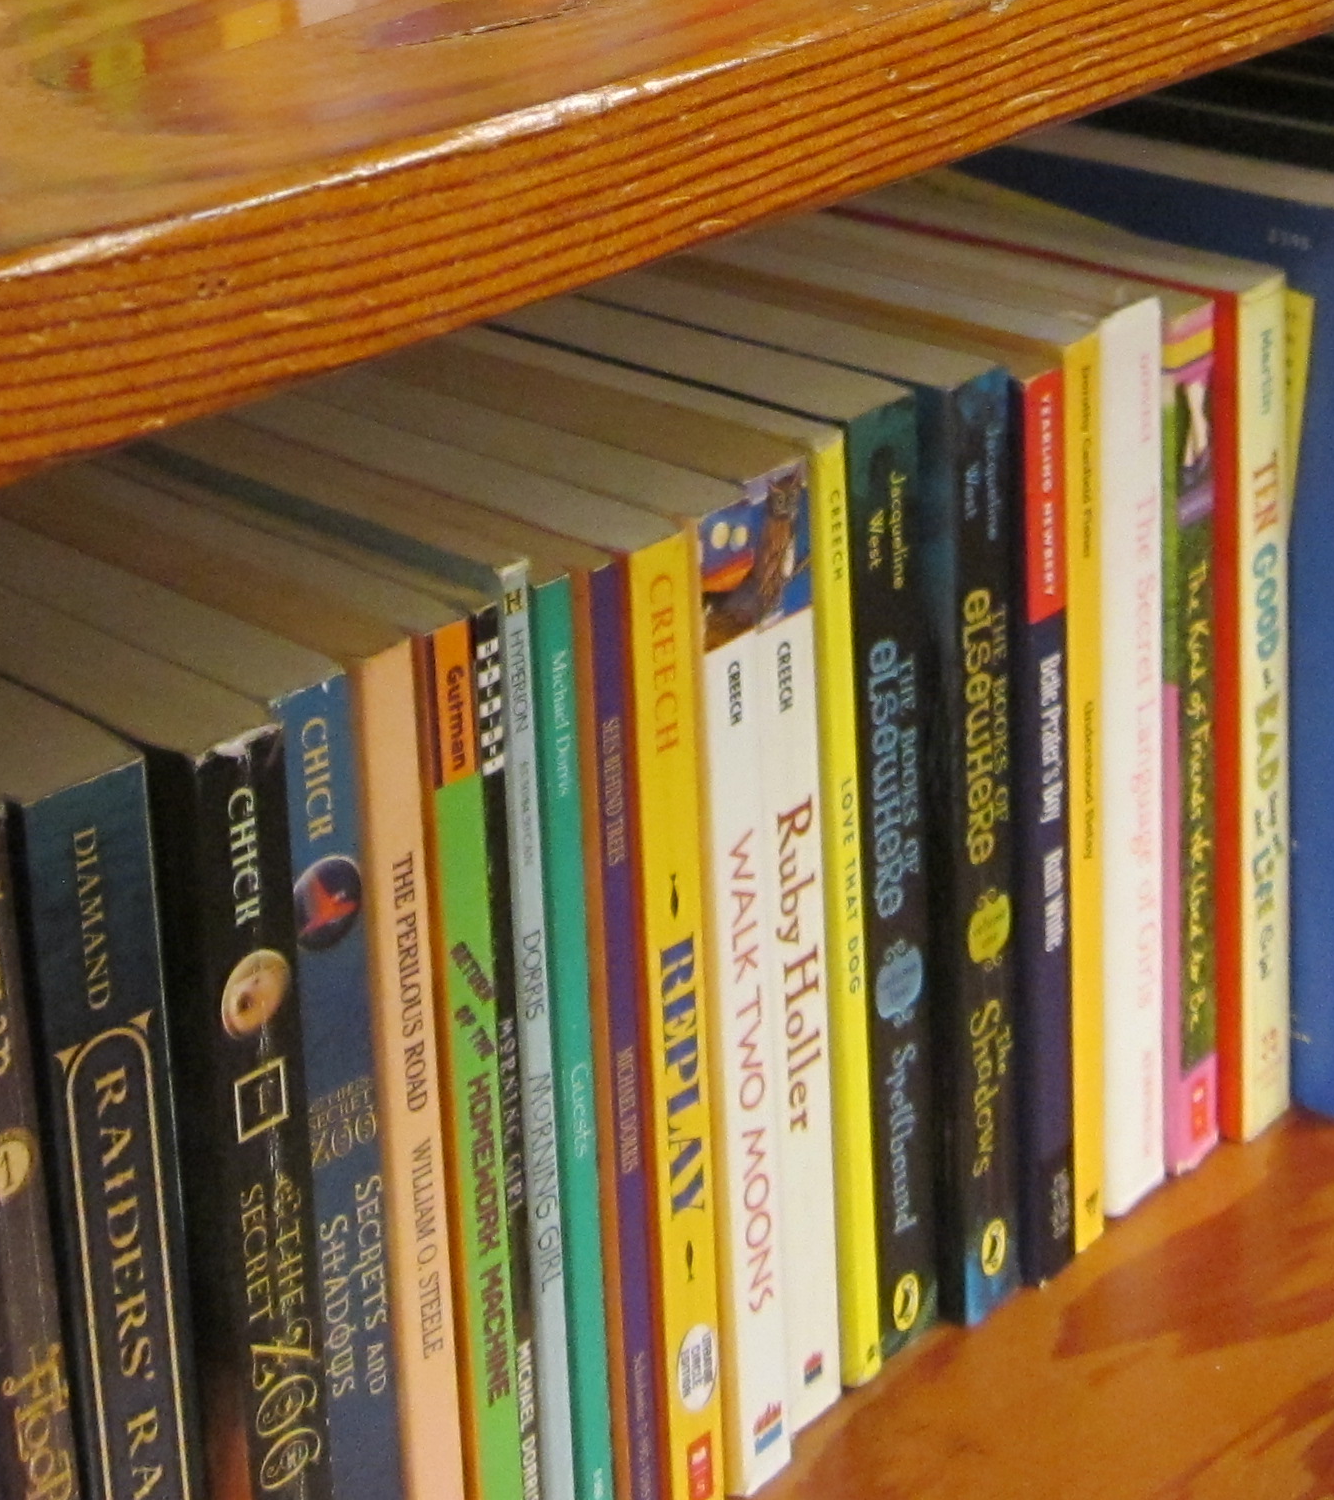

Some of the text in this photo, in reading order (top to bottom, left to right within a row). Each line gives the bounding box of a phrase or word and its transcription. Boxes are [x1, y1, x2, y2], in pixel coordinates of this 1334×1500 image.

[828, 490, 844, 583] CREECH
[868, 509, 887, 571] West
[888, 470, 906, 591] Jacqueline
[648, 573, 681, 754] CREECH
[1252, 541, 1280, 662] GOOD
[444, 665, 467, 772] Gutman
[510, 629, 530, 735] HYPERION
[551, 649, 571, 797] Michael Dorris
[726, 661, 742, 728] CREECH
[776, 641, 795, 714] CREECH
[1039, 650, 1061, 706] Belle
[1255, 691, 1280, 791] BAD
[300, 717, 334, 842] CHICK
[70, 825, 113, 1013] DIAMAND
[226, 787, 263, 928] CHICK
[839, 777, 863, 996] LOVE THAT DOG
[521, 928, 545, 1021] DORRIS
[775, 793, 822, 1133] Ruby Holler
[392, 851, 445, 1360] THE PERILOUS ROAD WILLIAM O. STEELE
[498, 1016, 522, 1144] MORNING
[568, 1061, 593, 1159] Guests
[615, 1047, 633, 1111] MICHAEL
[658, 933, 707, 1222] REPLAY
[726, 828, 776, 1316] WALK TWO MOONS
[884, 1041, 917, 1234] Spellbound
[969, 1000, 1002, 1178] Shadows
[90, 1067, 156, 1390] RAIDERS'
[240, 1182, 274, 1324] SECRET
[350, 1174, 388, 1332] SECRETS
[467, 1071, 511, 1408] HOMEWORK MACHINE
[527, 1072, 564, 1295] MORNING GIRL
[319, 1213, 358, 1399] SHADOWS
[516, 1339, 536, 1432] MICHAEL
